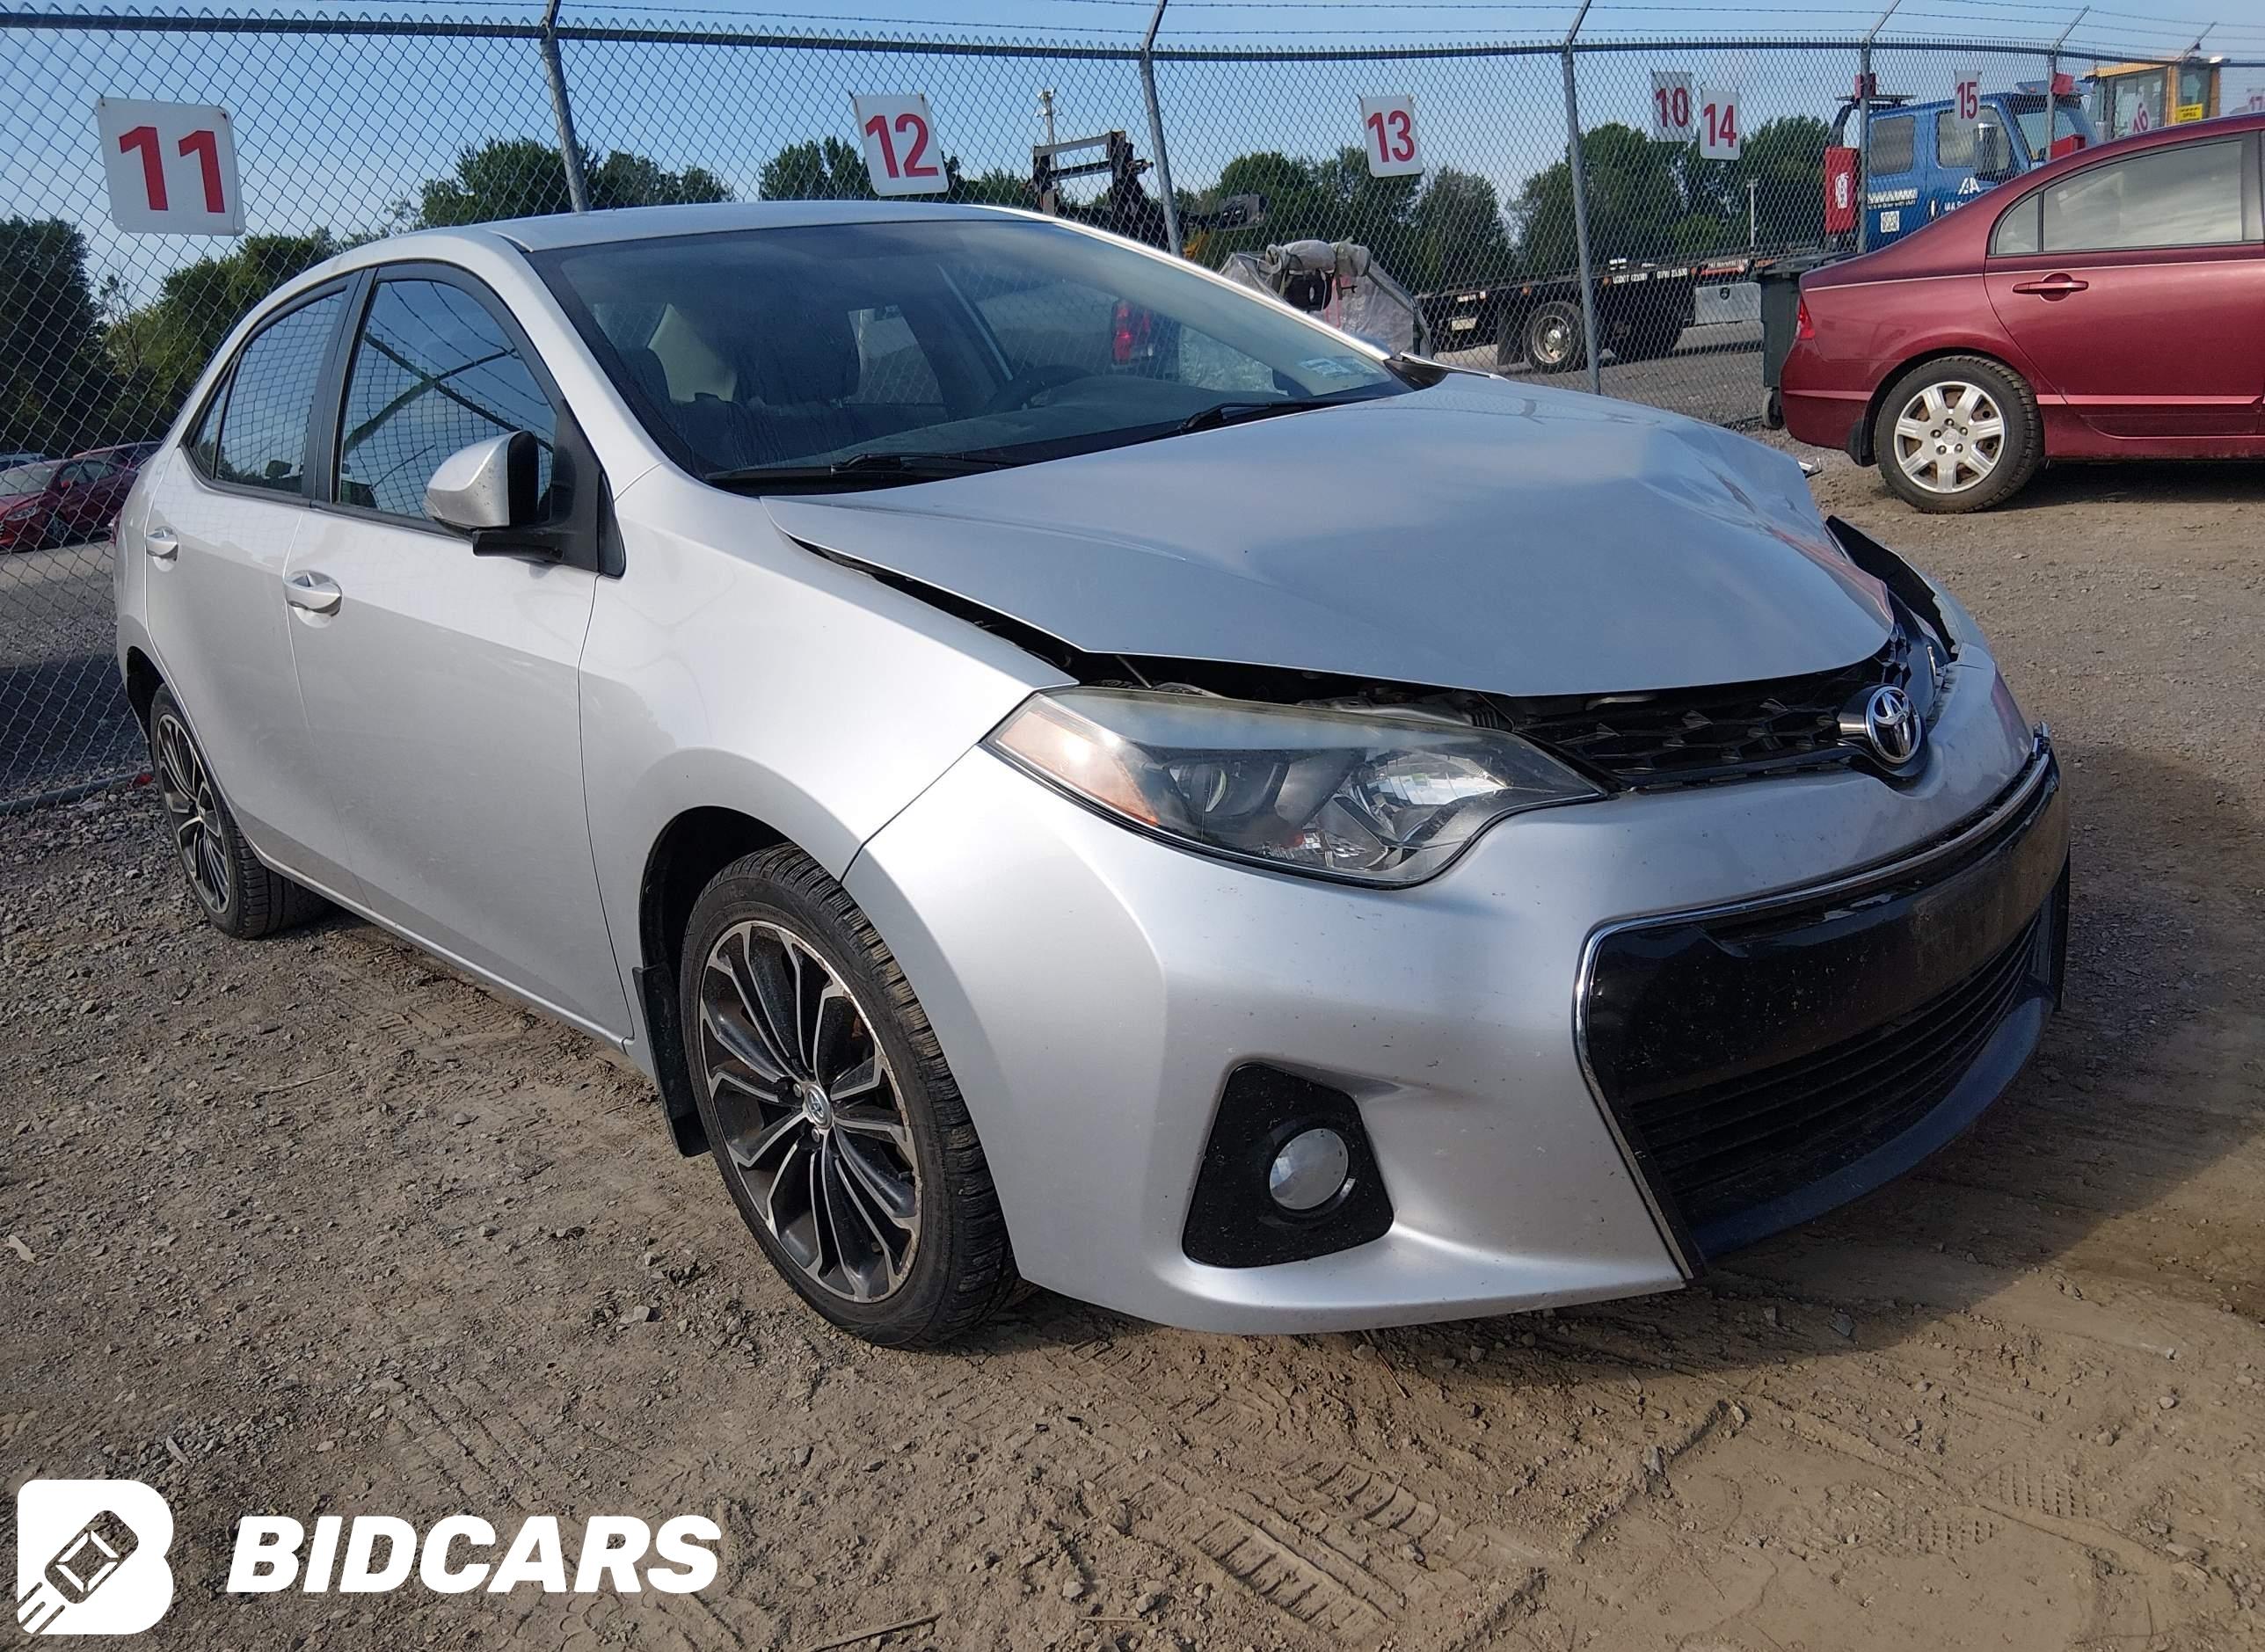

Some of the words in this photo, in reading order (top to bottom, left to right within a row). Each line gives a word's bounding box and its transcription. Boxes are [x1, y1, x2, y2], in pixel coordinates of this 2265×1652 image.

[1656, 87, 1689, 128] 10
[1956, 81, 1977, 120] 15
[865, 113, 939, 178] 12
[1367, 110, 1415, 163] 13
[1703, 103, 1737, 148] 14
[119, 126, 225, 213] 11
